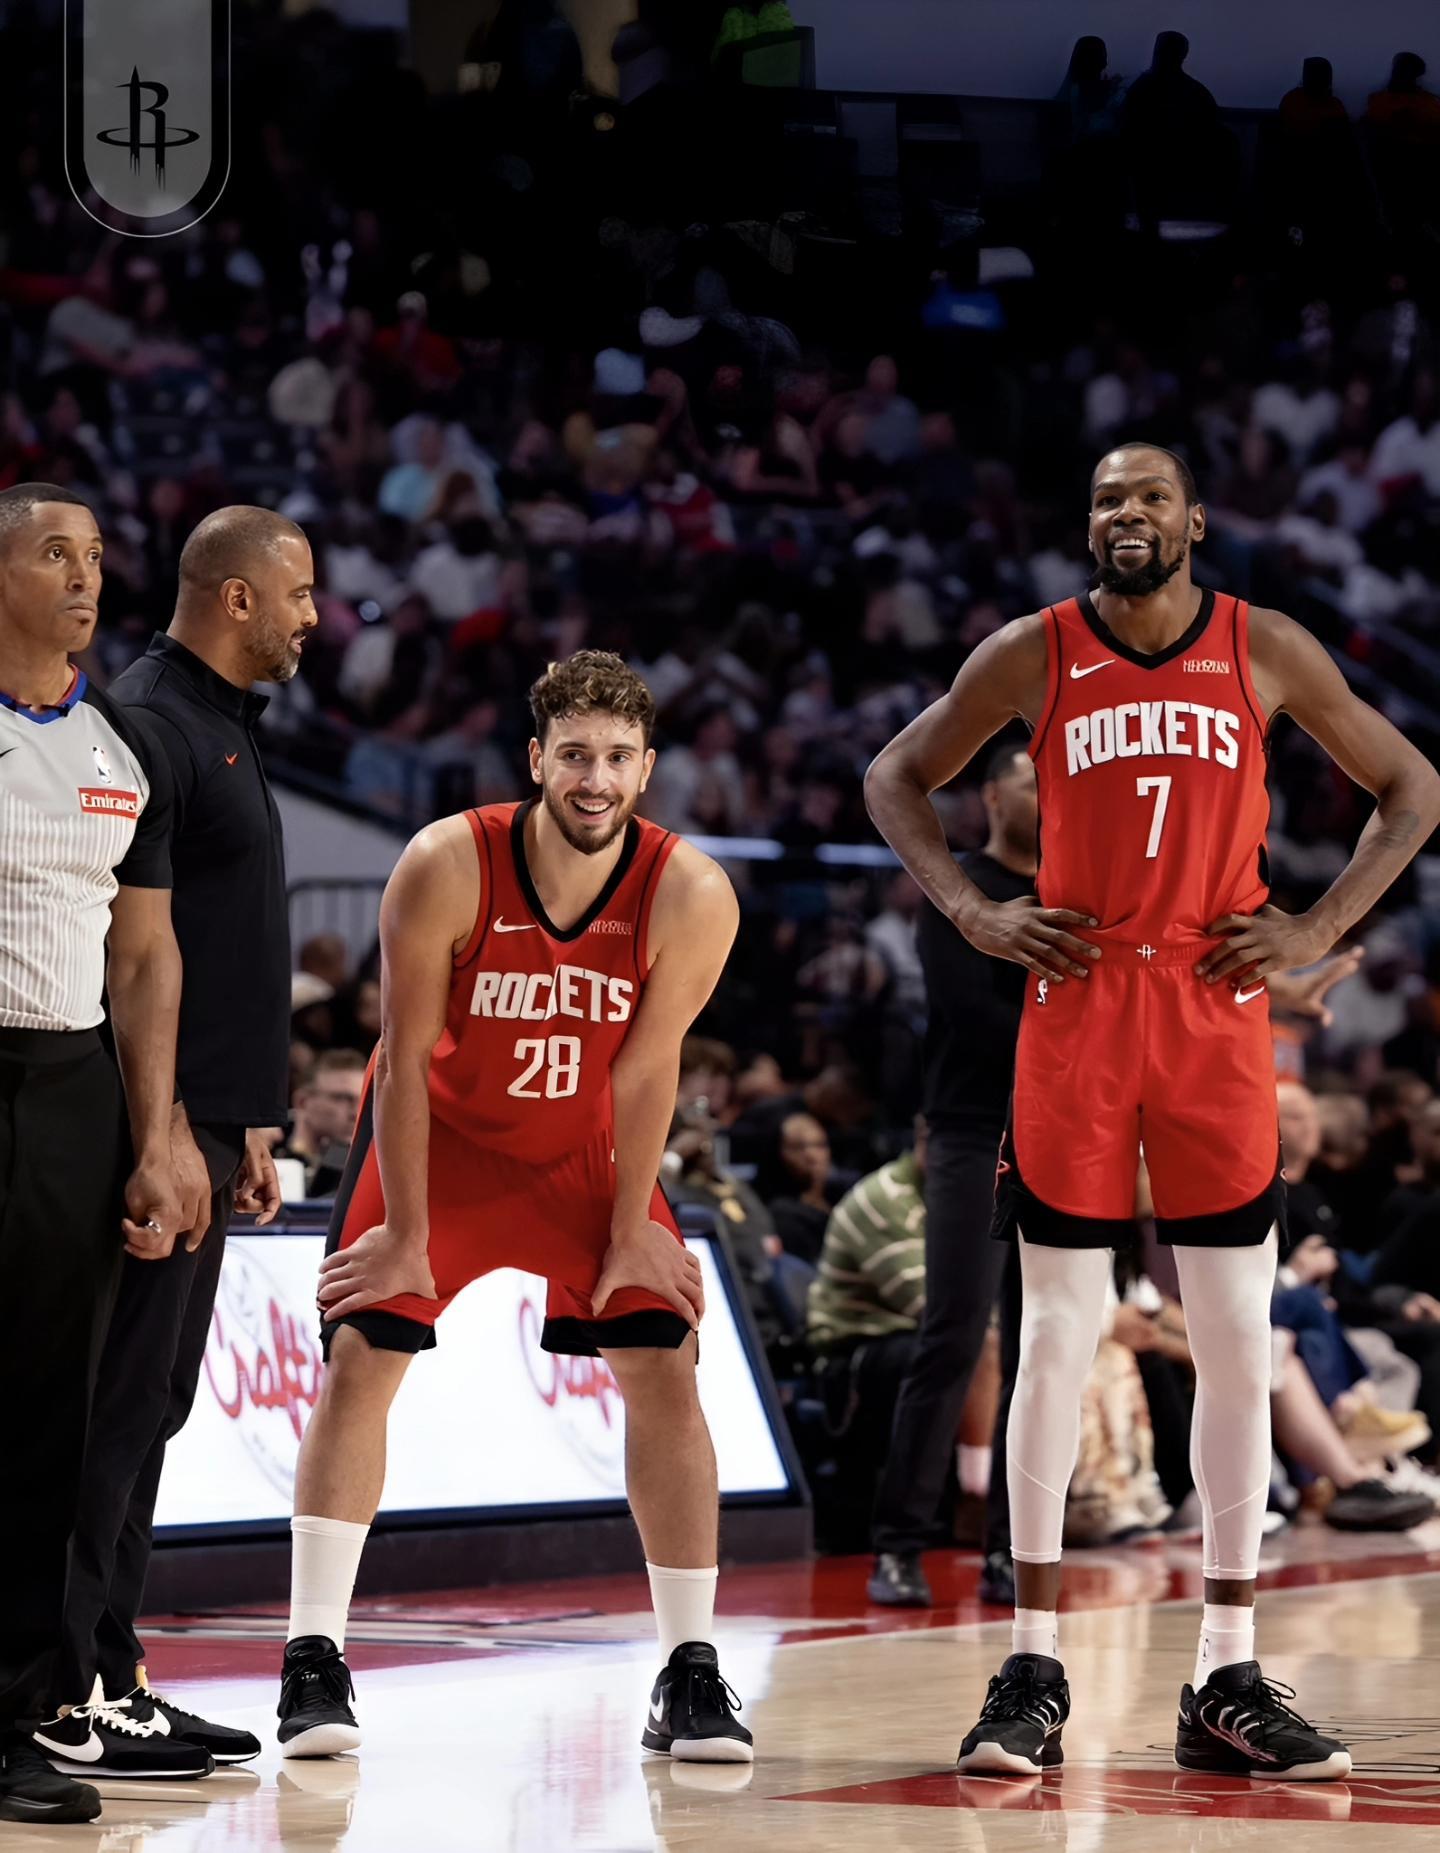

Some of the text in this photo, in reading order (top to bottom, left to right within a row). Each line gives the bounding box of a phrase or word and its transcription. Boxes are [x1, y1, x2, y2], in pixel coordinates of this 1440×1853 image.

[1064, 700, 1241, 777] ROCKETS
[1136, 775, 1173, 858] 7
[506, 1035, 582, 1099] 28
